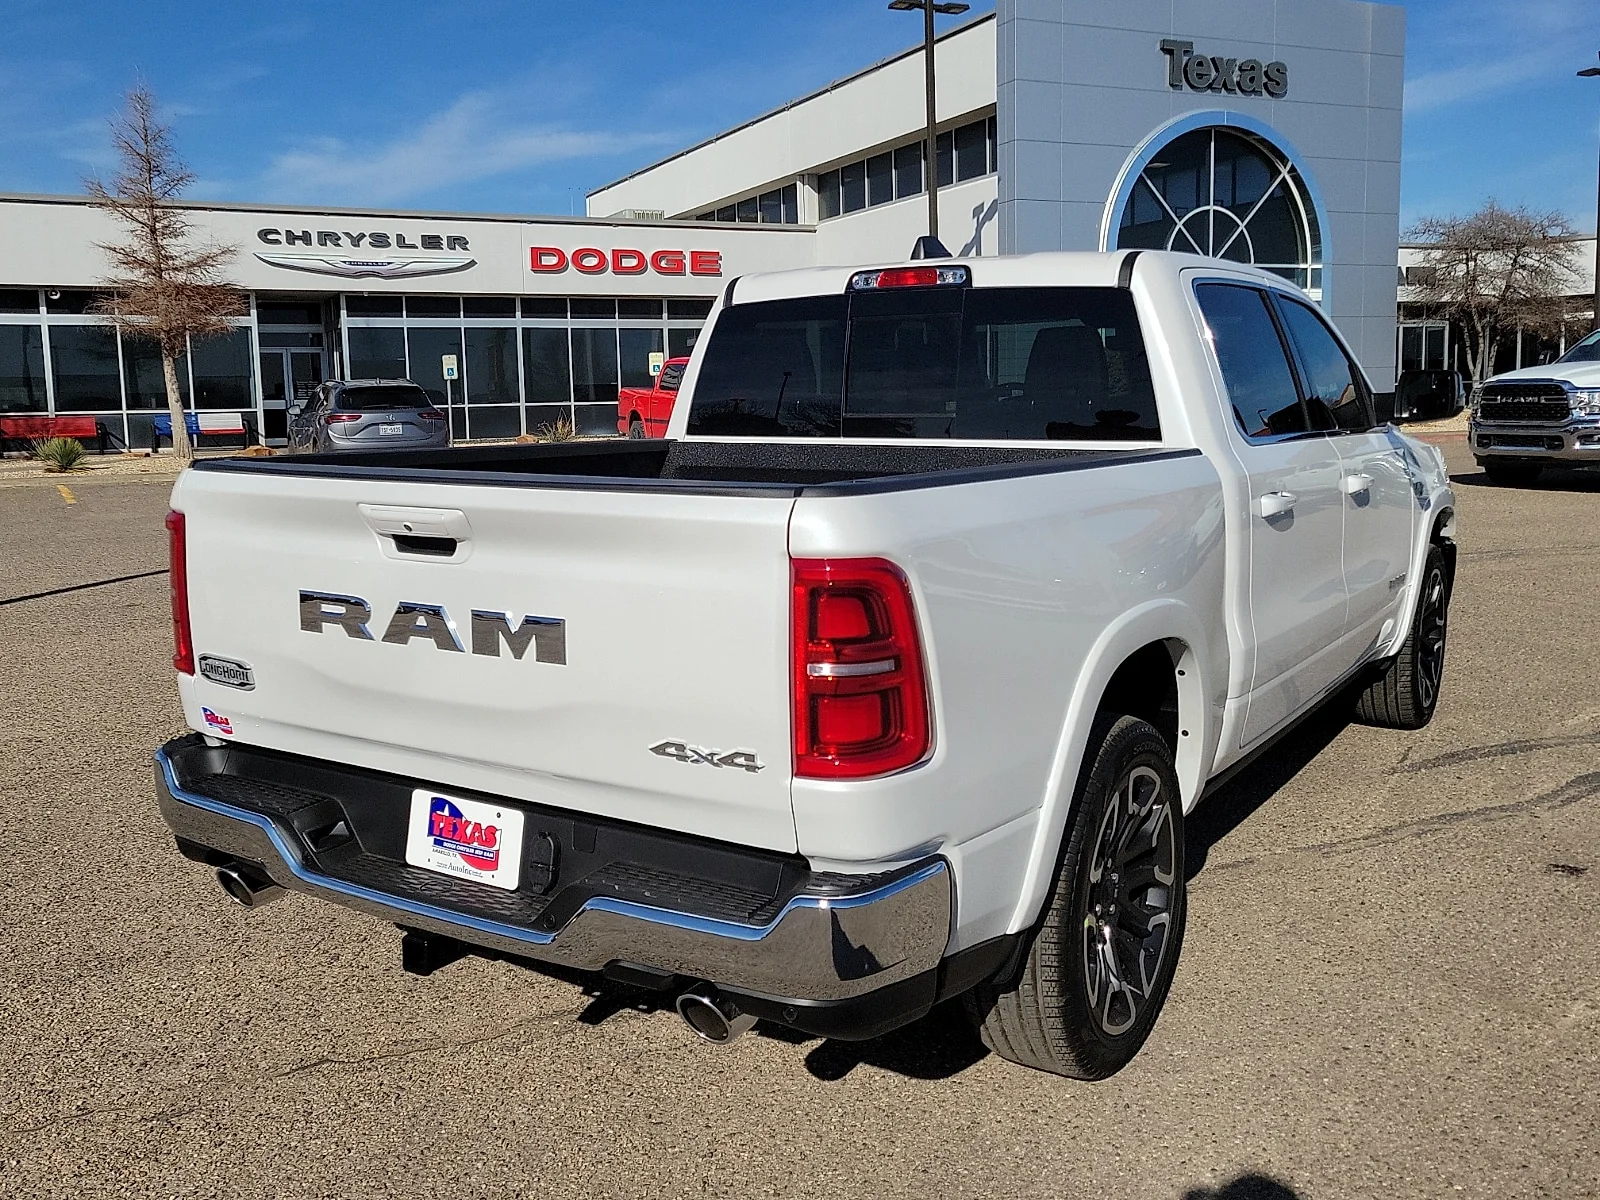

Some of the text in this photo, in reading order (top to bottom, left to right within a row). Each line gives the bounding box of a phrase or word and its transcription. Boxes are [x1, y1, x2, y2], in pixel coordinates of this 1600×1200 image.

[1160, 39, 1288, 99] Texas
[257, 228, 470, 251] CHRYSLER
[530, 247, 723, 277] DODGE
[299, 589, 567, 666] RAM
[200, 663, 250, 682] LONGHORN
[431, 812, 497, 849] TEXAS
